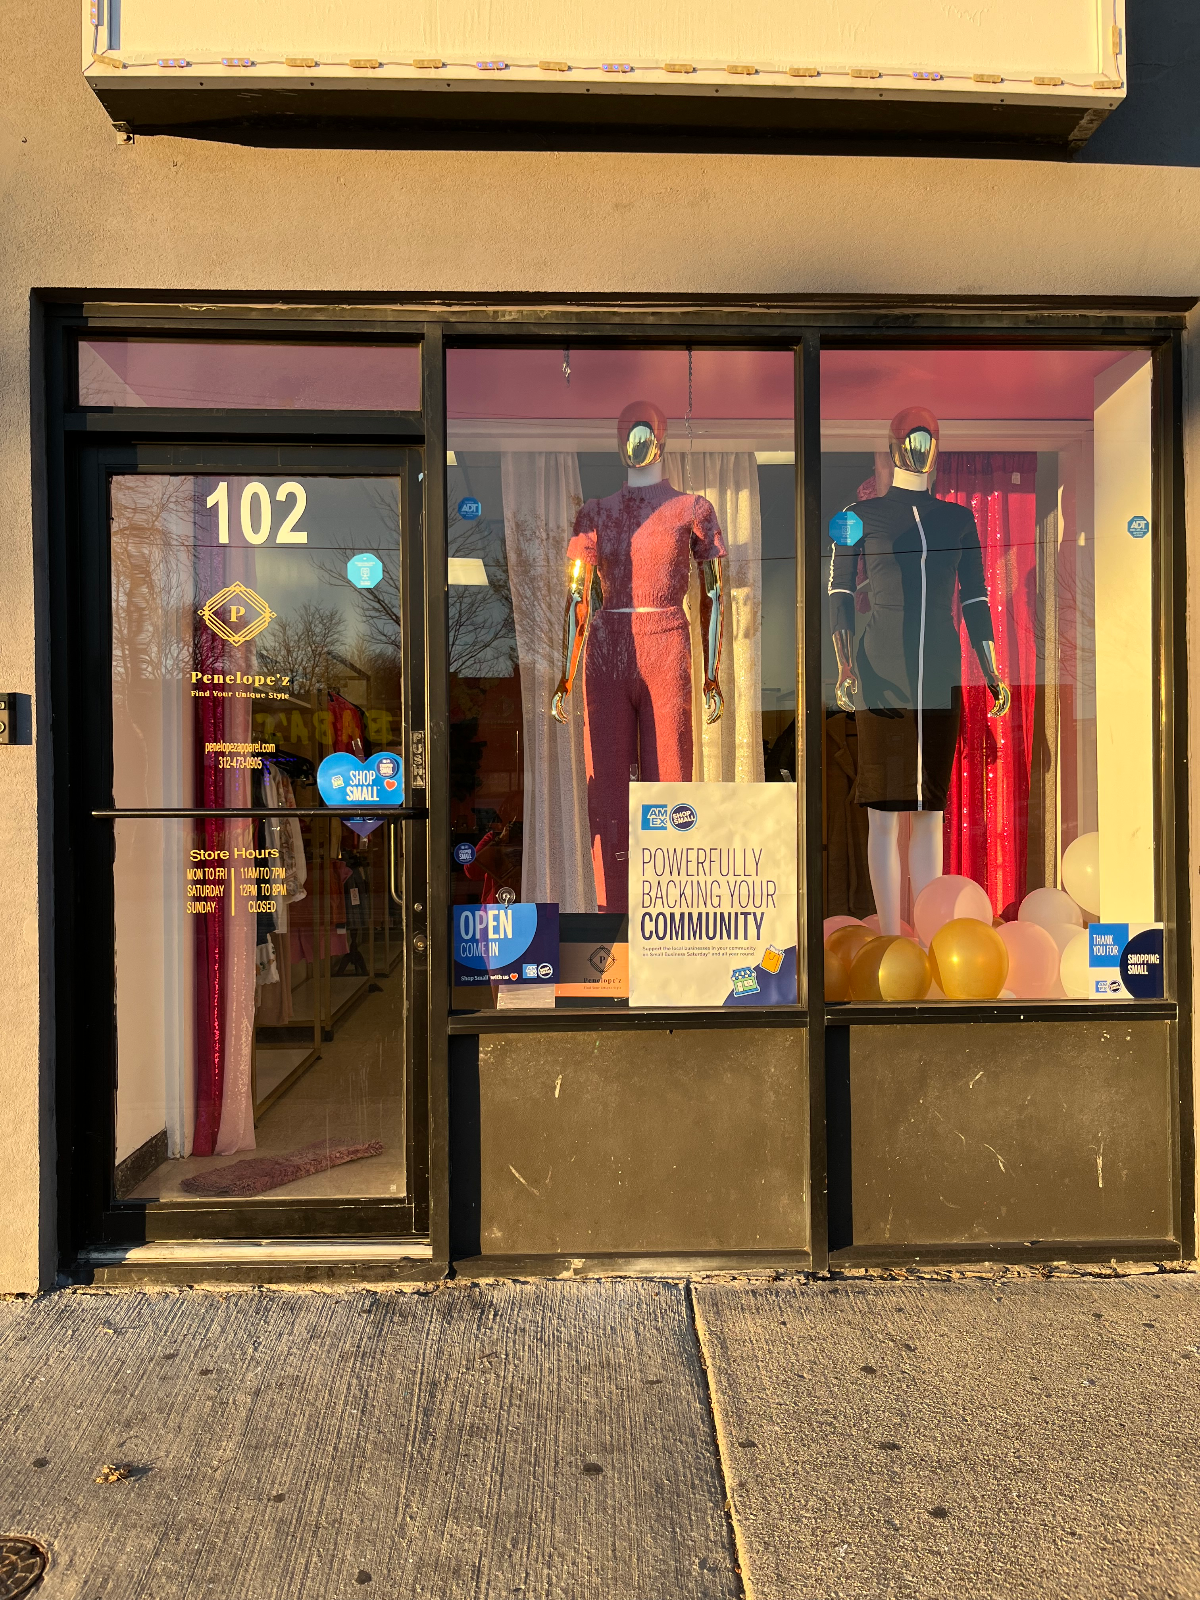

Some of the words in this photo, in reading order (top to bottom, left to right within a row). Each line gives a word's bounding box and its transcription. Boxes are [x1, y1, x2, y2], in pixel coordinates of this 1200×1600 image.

[206, 481, 308, 545] 102
[461, 503, 478, 512] ADT
[1130, 520, 1147, 529] ADT
[229, 605, 246, 622] P
[190, 671, 290, 687] Penelope'z
[235, 691, 266, 699] Unique
[268, 692, 290, 700] Style
[205, 740, 276, 754] penelopezapparel.com
[412, 732, 423, 776] PUSH
[218, 756, 263, 769] 312-473-0905
[349, 770, 376, 785] SHOP
[346, 786, 380, 801] SMALL
[648, 808, 667, 817] AM
[672, 810, 691, 819] SHOP
[673, 815, 696, 825] SMALL
[189, 849, 230, 862] Store
[234, 847, 279, 859] Hours
[641, 847, 763, 877] POWERFULLY
[186, 868, 203, 880] MON
[204, 868, 215, 880] TO
[215, 868, 228, 880] FRI
[240, 867, 259, 879] 11AM
[260, 867, 270, 879] TO
[271, 867, 286, 879] 7PM
[187, 884, 225, 897] SATURDAY
[239, 884, 258, 896] 12PM
[260, 884, 271, 896] TO
[272, 883, 288, 896] 8PM
[641, 879, 722, 909] BACKING
[726, 879, 777, 909] YOUR
[186, 901, 216, 914] SUNDAY
[248, 900, 277, 913] CLOSED
[459, 909, 513, 940] OPEN
[640, 911, 765, 941] COMMUNITY
[1092, 934, 1114, 945] THANK
[460, 942, 487, 957] COME
[488, 942, 499, 957] IN
[1092, 945, 1106, 956] YOU
[1106, 945, 1119, 956] FOR
[599, 955, 606, 964] P
[1127, 953, 1160, 964] SHOPPING
[1127, 964, 1149, 975] SMALL
